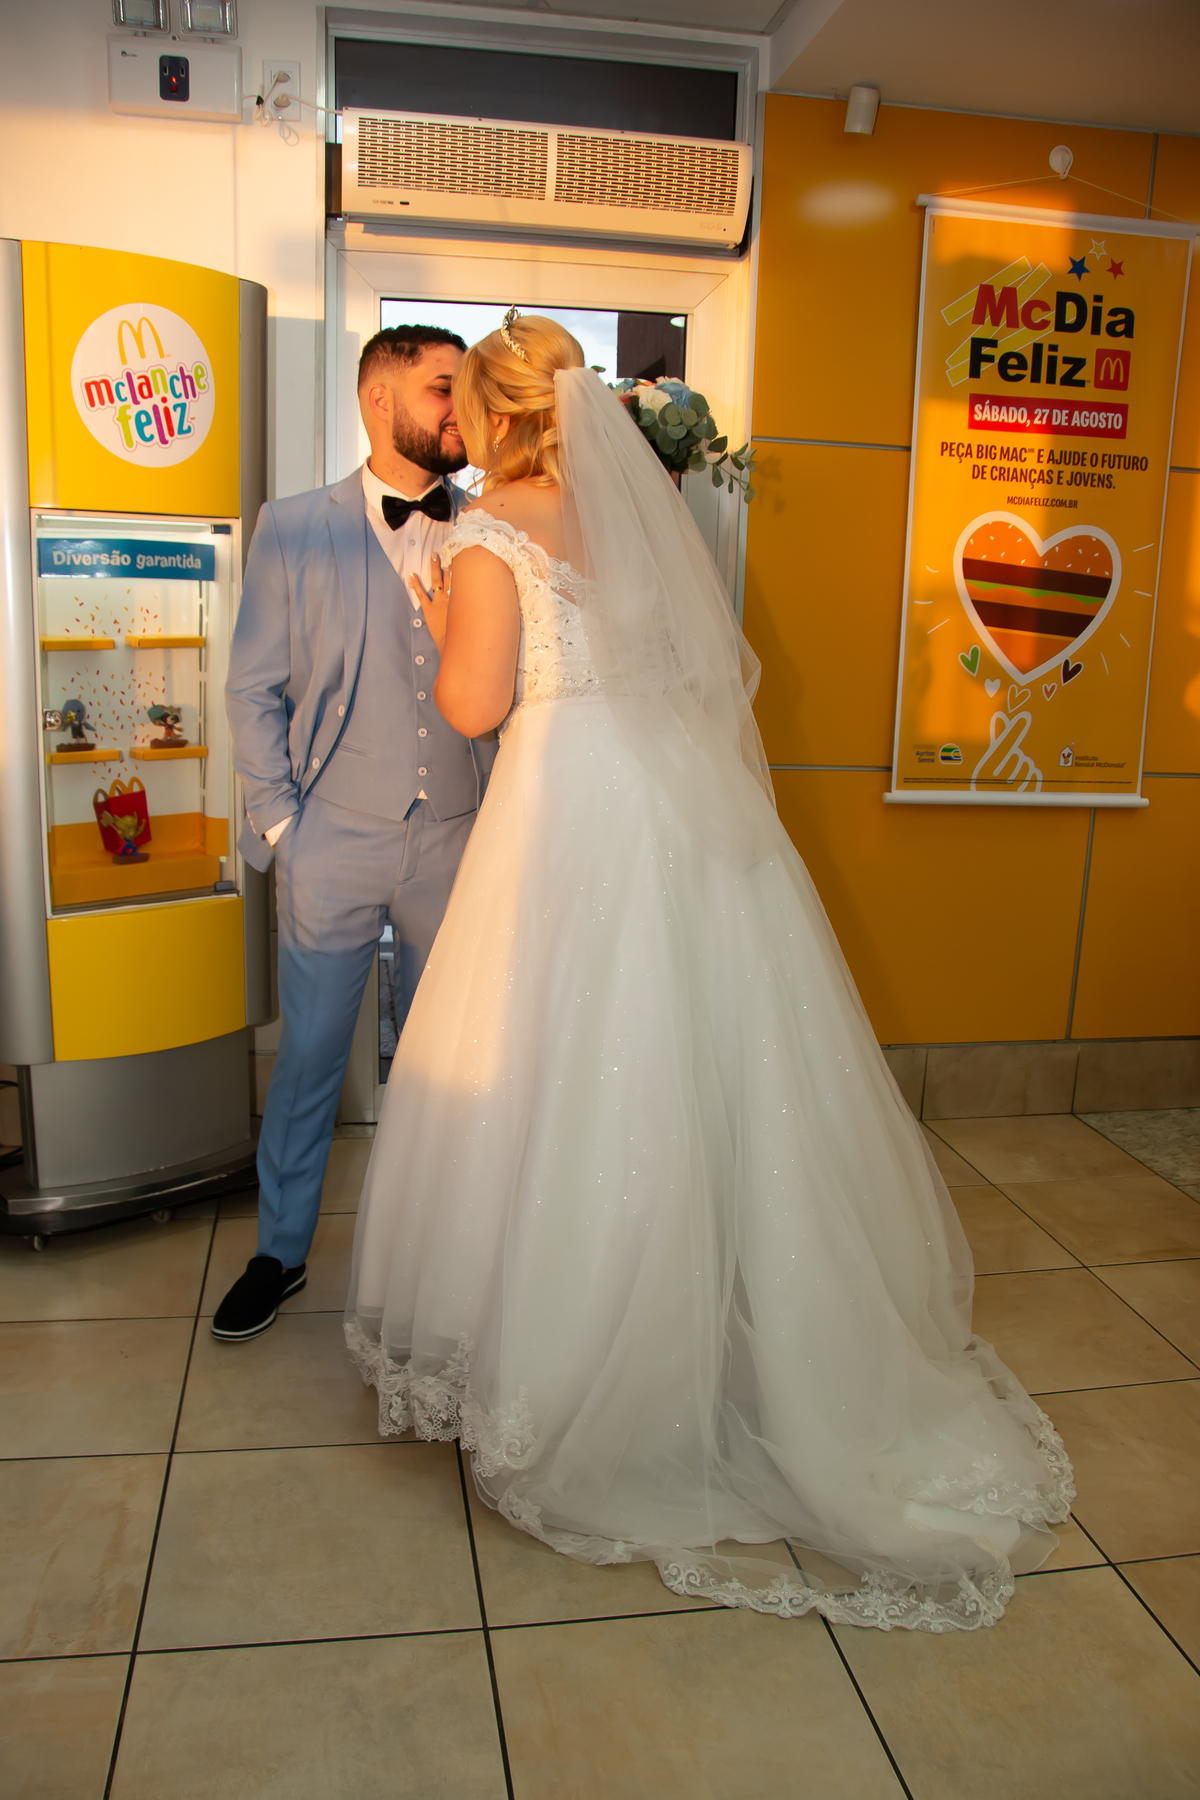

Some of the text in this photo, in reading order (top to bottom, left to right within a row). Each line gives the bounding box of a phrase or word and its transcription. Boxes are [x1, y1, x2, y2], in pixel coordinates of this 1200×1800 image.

[971, 284, 1135, 339] McDia
[969, 337, 1087, 388] Feliz
[84, 364, 207, 408] mclanche
[116, 396, 192, 449] feliz
[973, 400, 1123, 430] SÁBADO, 27 DE AGOSTO
[940, 441, 973, 463] PEÇA
[976, 443, 997, 460] BIG
[1037, 448, 1045, 463] E
[1047, 449, 1089, 468] AJUDE
[1090, 452, 1099, 468] O
[1101, 453, 1149, 471] FUTURO
[972, 464, 1116, 490] DE CRIANÇAS E JOVENS.
[1006, 496, 1079, 509] MCDIAFELIZ.COM.BR
[52, 550, 202, 570] Diversão garantida
